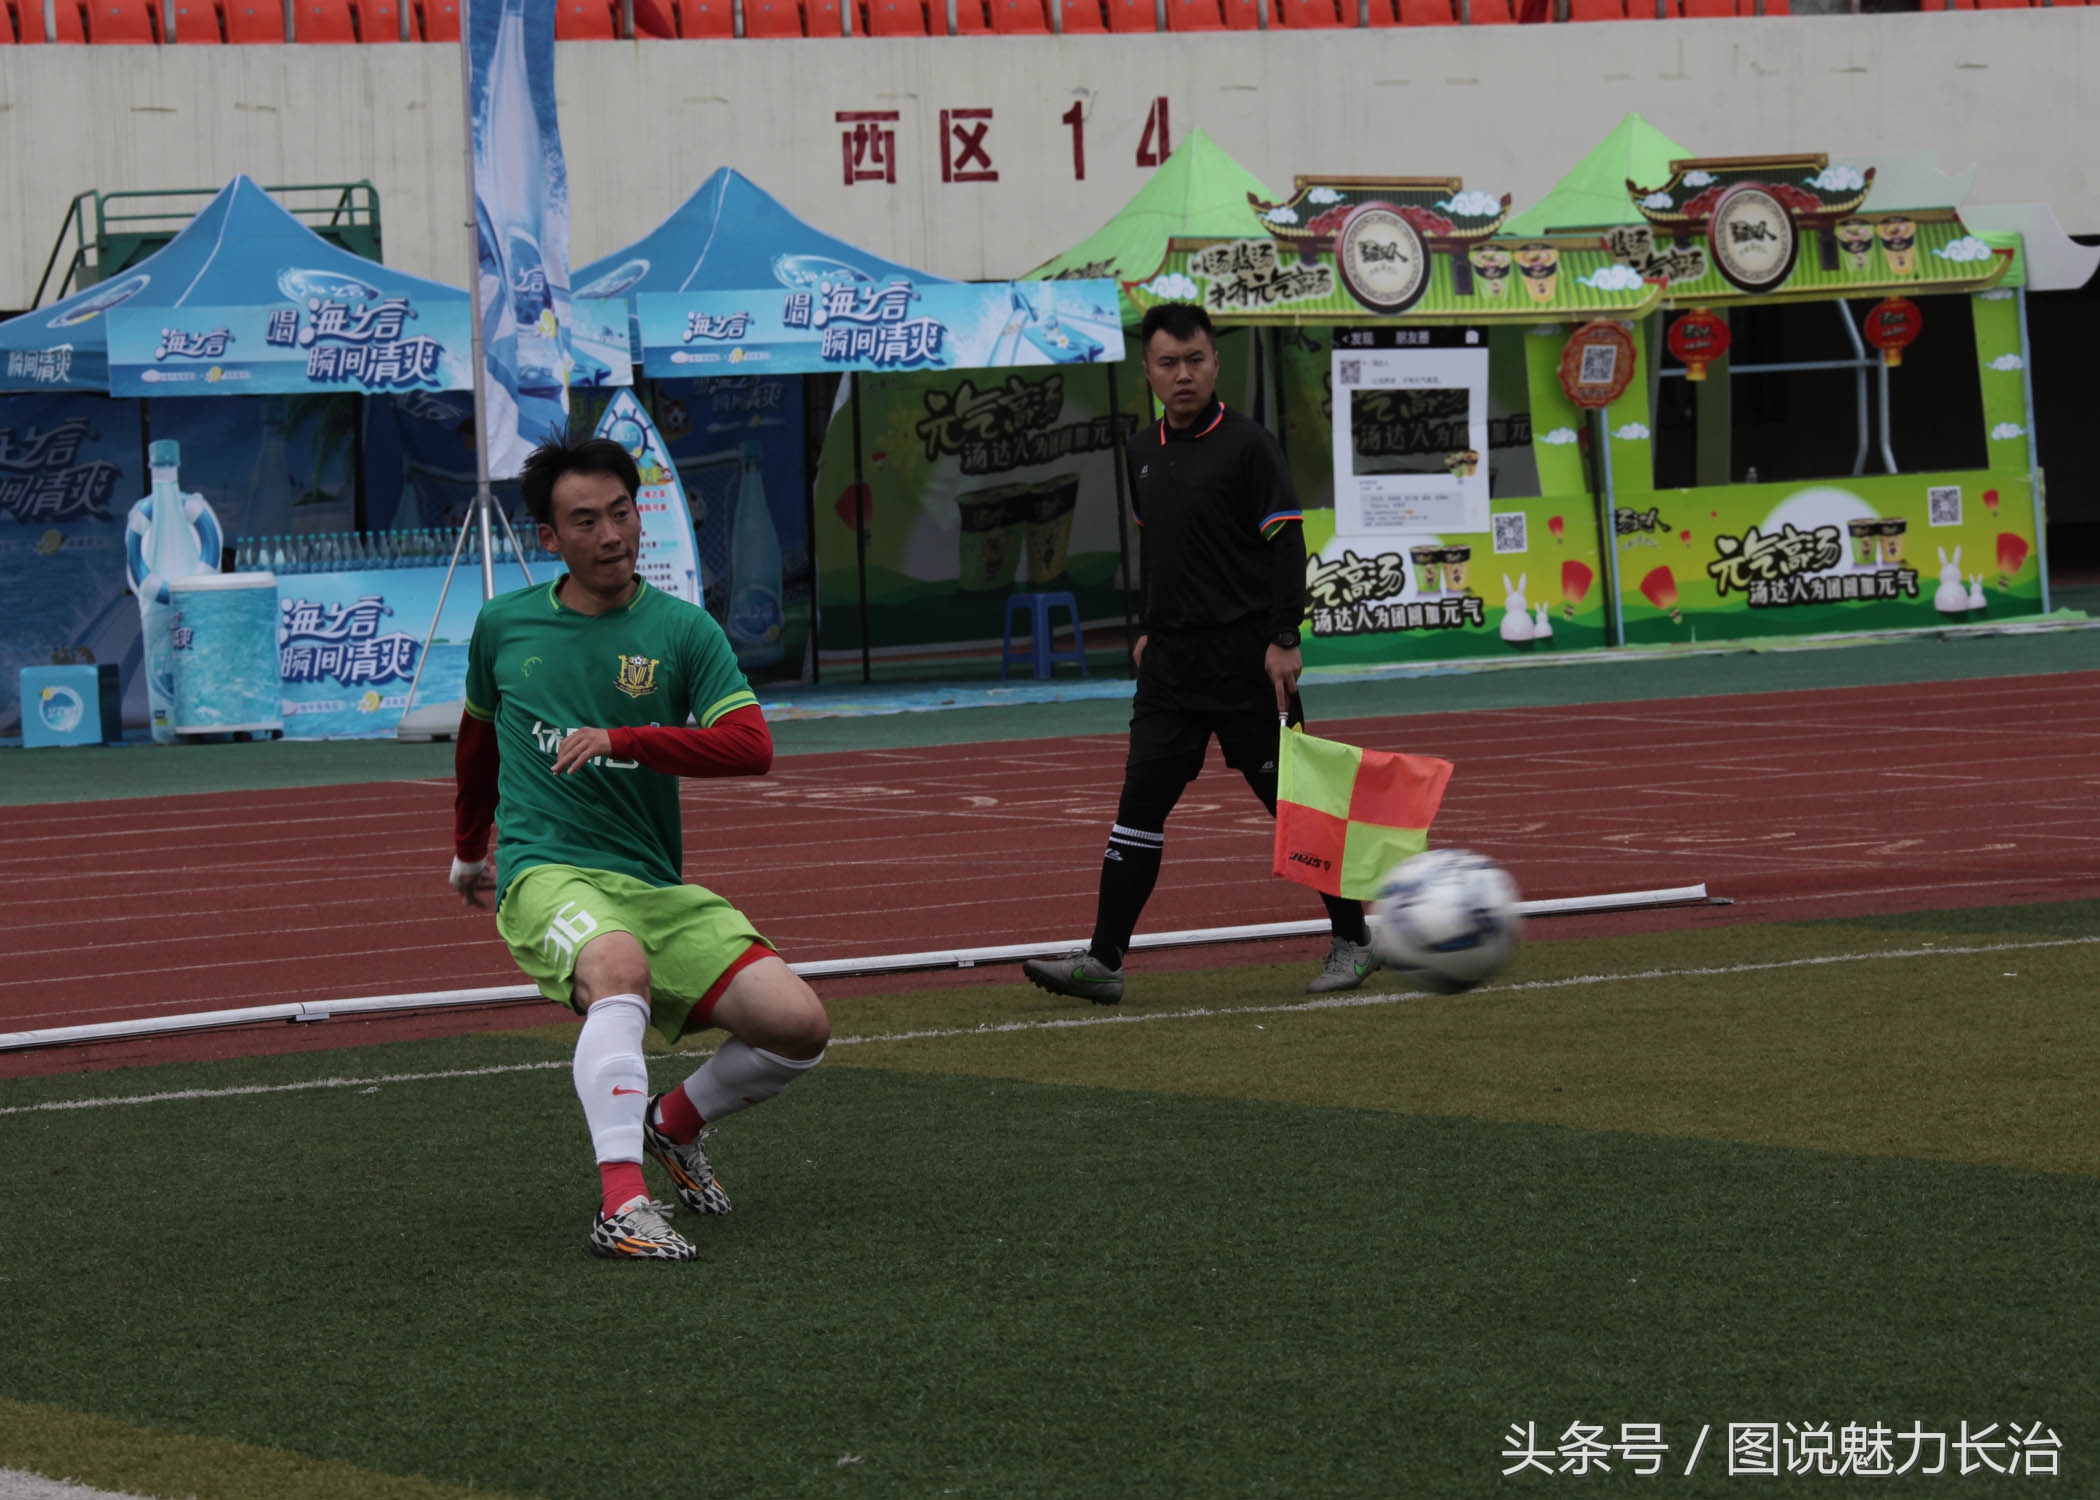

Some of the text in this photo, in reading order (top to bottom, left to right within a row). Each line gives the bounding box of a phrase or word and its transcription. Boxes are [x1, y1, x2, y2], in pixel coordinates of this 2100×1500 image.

[835, 108, 999, 185] 西区
[265, 297, 418, 346] 喝海之言
[682, 310, 755, 342] 海之言
[782, 280, 922, 328] 喝海之言
[155, 327, 235, 360] 海之言
[306, 335, 444, 385] 瞬间清爽
[820, 316, 948, 365] 瞬间清爽
[1708, 522, 1841, 596] 元气高汤
[280, 595, 393, 644] 海之言
[280, 631, 422, 685] 瞬间清爽
